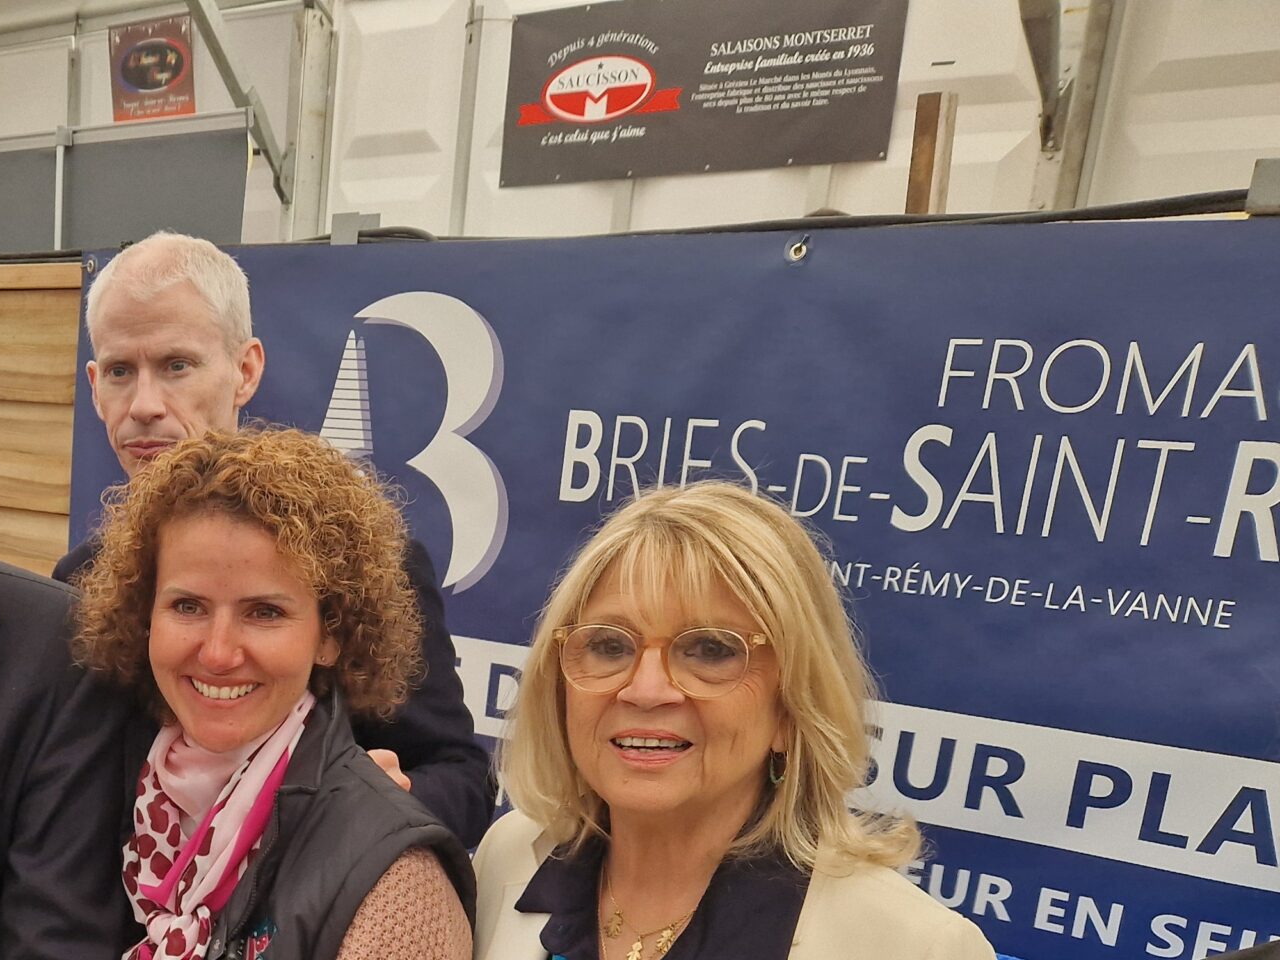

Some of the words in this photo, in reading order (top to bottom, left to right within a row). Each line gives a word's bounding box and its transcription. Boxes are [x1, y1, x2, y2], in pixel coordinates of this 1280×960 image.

[547, 37, 585, 67] Depuis
[588, 36, 595, 47] 4
[596, 30, 659, 55] générations
[710, 35, 781, 57] SALAISONS
[783, 24, 874, 48] MONTSERRET
[704, 60, 754, 75] Entreprise
[754, 51, 803, 71] familiale
[804, 49, 831, 63] créée
[832, 50, 845, 60] en
[846, 43, 875, 59] 1936
[557, 68, 640, 90] SAUCISSON
[783, 73, 799, 83] dans
[800, 72, 810, 81] les
[833, 69, 843, 78] du
[564, 128, 588, 143] celui
[590, 129, 609, 145] que
[611, 125, 646, 142] j'aime
[938, 338, 1268, 421] FROMA
[1065, 759, 1278, 868] PLA
[1033, 886, 1124, 948] EN
